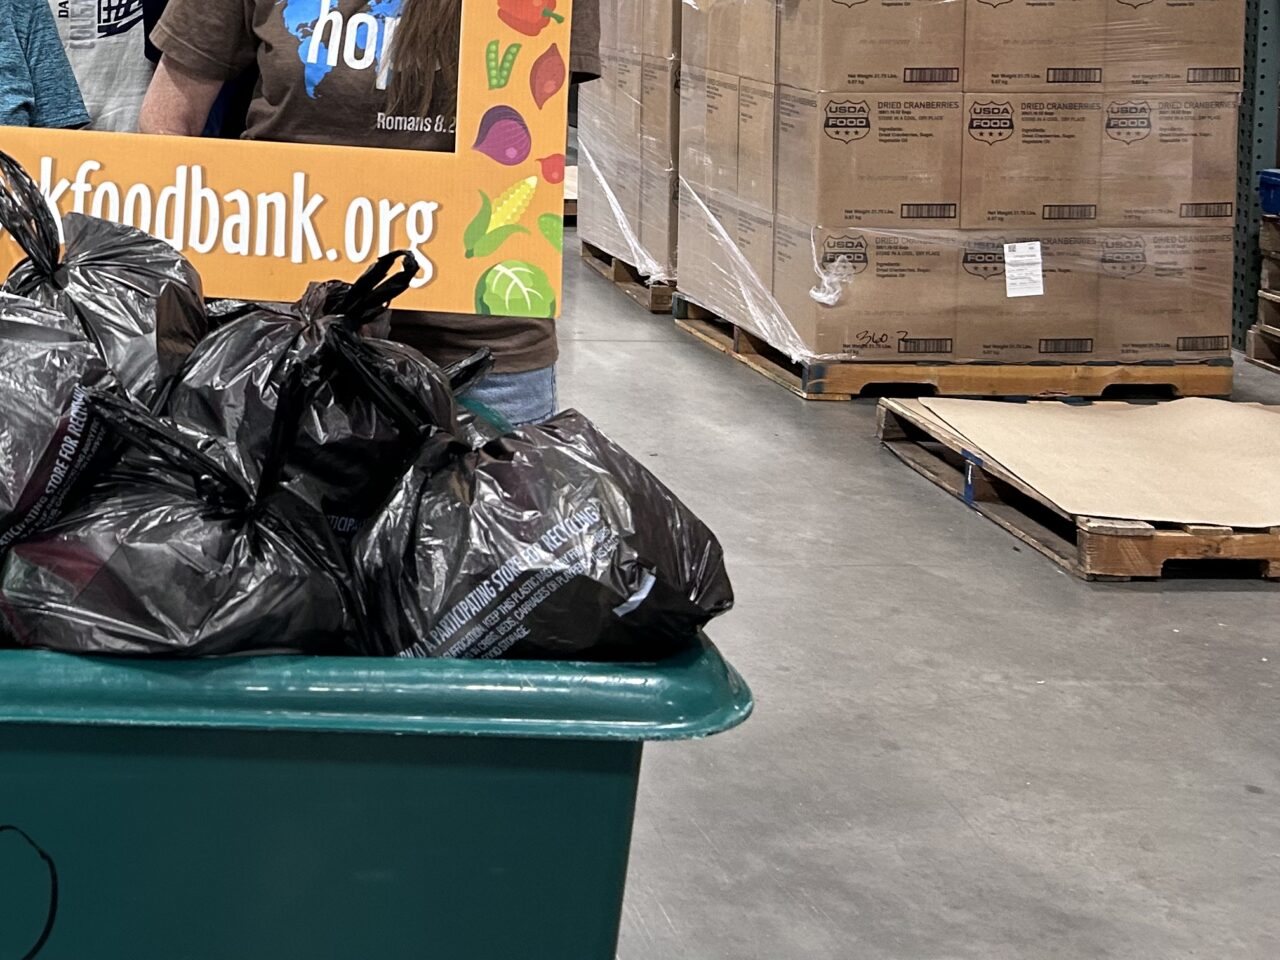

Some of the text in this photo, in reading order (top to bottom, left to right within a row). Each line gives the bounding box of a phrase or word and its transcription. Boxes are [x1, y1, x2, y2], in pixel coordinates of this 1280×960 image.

[877, 101, 959, 109] DRIED CRANBERRIES
[1184, 101, 1237, 109] CRANBERRIES
[829, 106, 866, 114] USDA
[973, 107, 1010, 115] USDA
[377, 112, 432, 131] Romans
[1105, 241, 1142, 249] USDA
[968, 254, 1004, 262] FOOD
[45, 460, 70, 496] STORE
[59, 435, 79, 465] FOR
[429, 584, 497, 641] PARTICIPATING
[490, 556, 526, 590] STORE
[542, 503, 599, 553] RECYCLING
[483, 610, 501, 628] KEEP
[498, 597, 515, 614] THIS
[511, 577, 539, 602] PLASTIC
[497, 616, 518, 635] BEDS,
[514, 588, 550, 619] CARRIAGES
